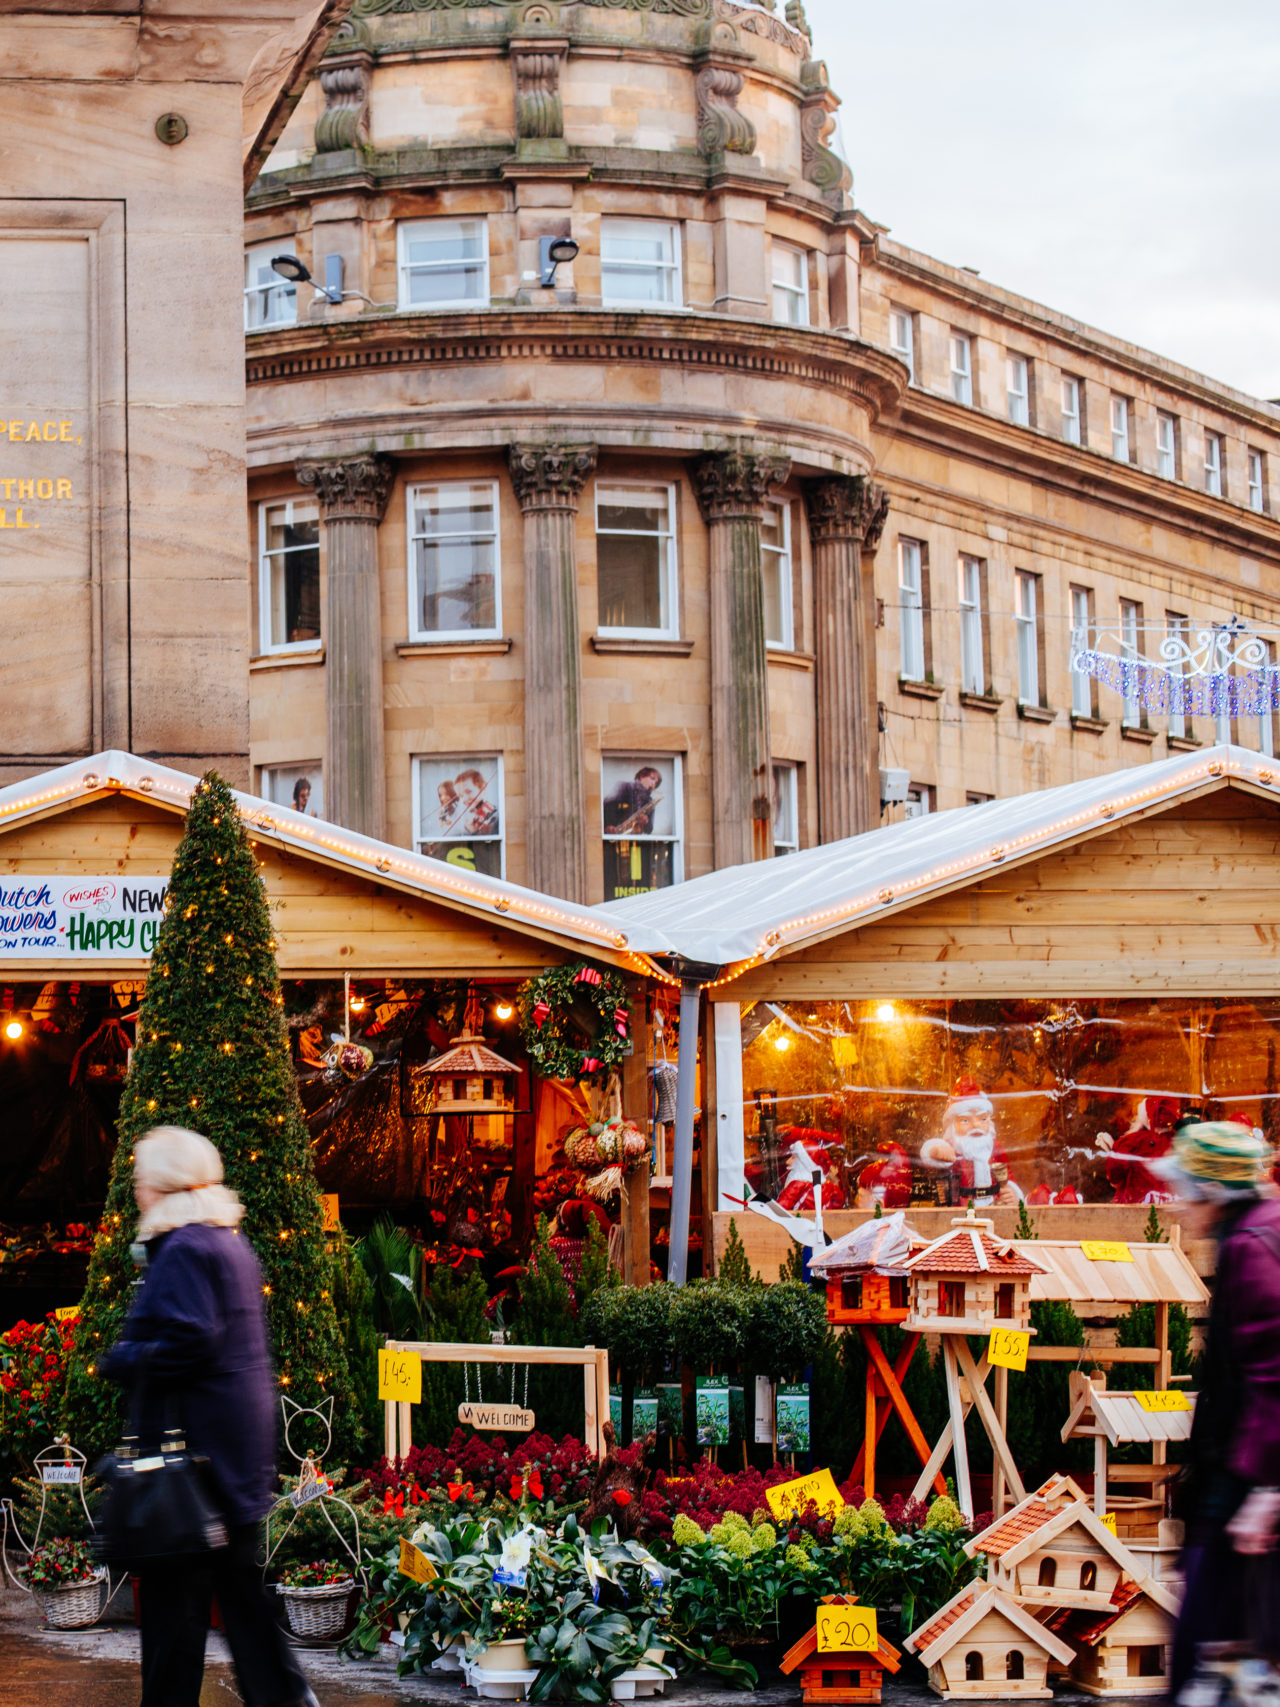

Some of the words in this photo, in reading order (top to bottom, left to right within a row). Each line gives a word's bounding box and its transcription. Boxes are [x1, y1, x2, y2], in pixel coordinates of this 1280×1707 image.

[69, 886, 109, 904] WISHES
[66, 913, 134, 951] HAPPY
[477, 1412, 529, 1426] WELCOME
